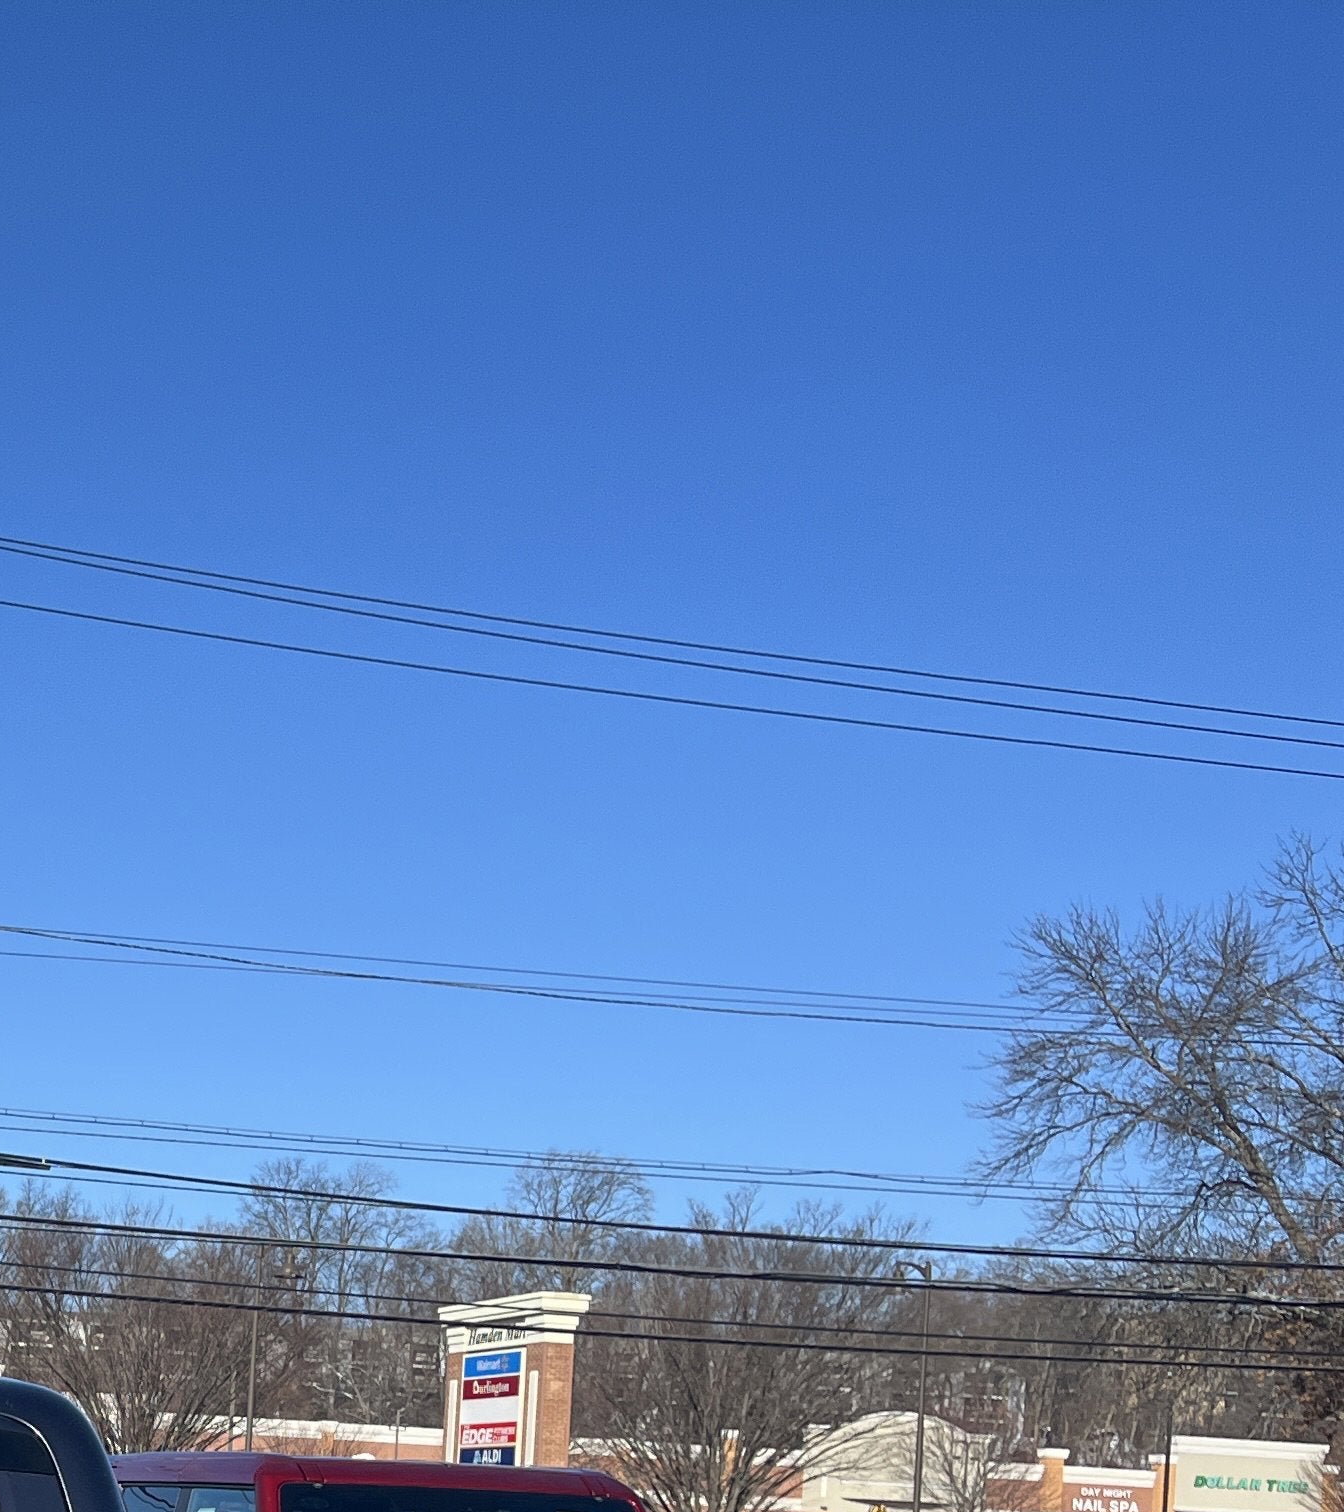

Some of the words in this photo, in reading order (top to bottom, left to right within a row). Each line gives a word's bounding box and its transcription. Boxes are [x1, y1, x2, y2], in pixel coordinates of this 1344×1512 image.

[469, 1328, 503, 1346] Hamden
[462, 1427, 494, 1445] EDGE
[482, 1449, 502, 1464] ALDI
[1193, 1475, 1262, 1492] DOLLAR
[1080, 1487, 1102, 1498] DAY
[1103, 1488, 1134, 1499] NIGHT
[1072, 1497, 1107, 1512] NAIL
